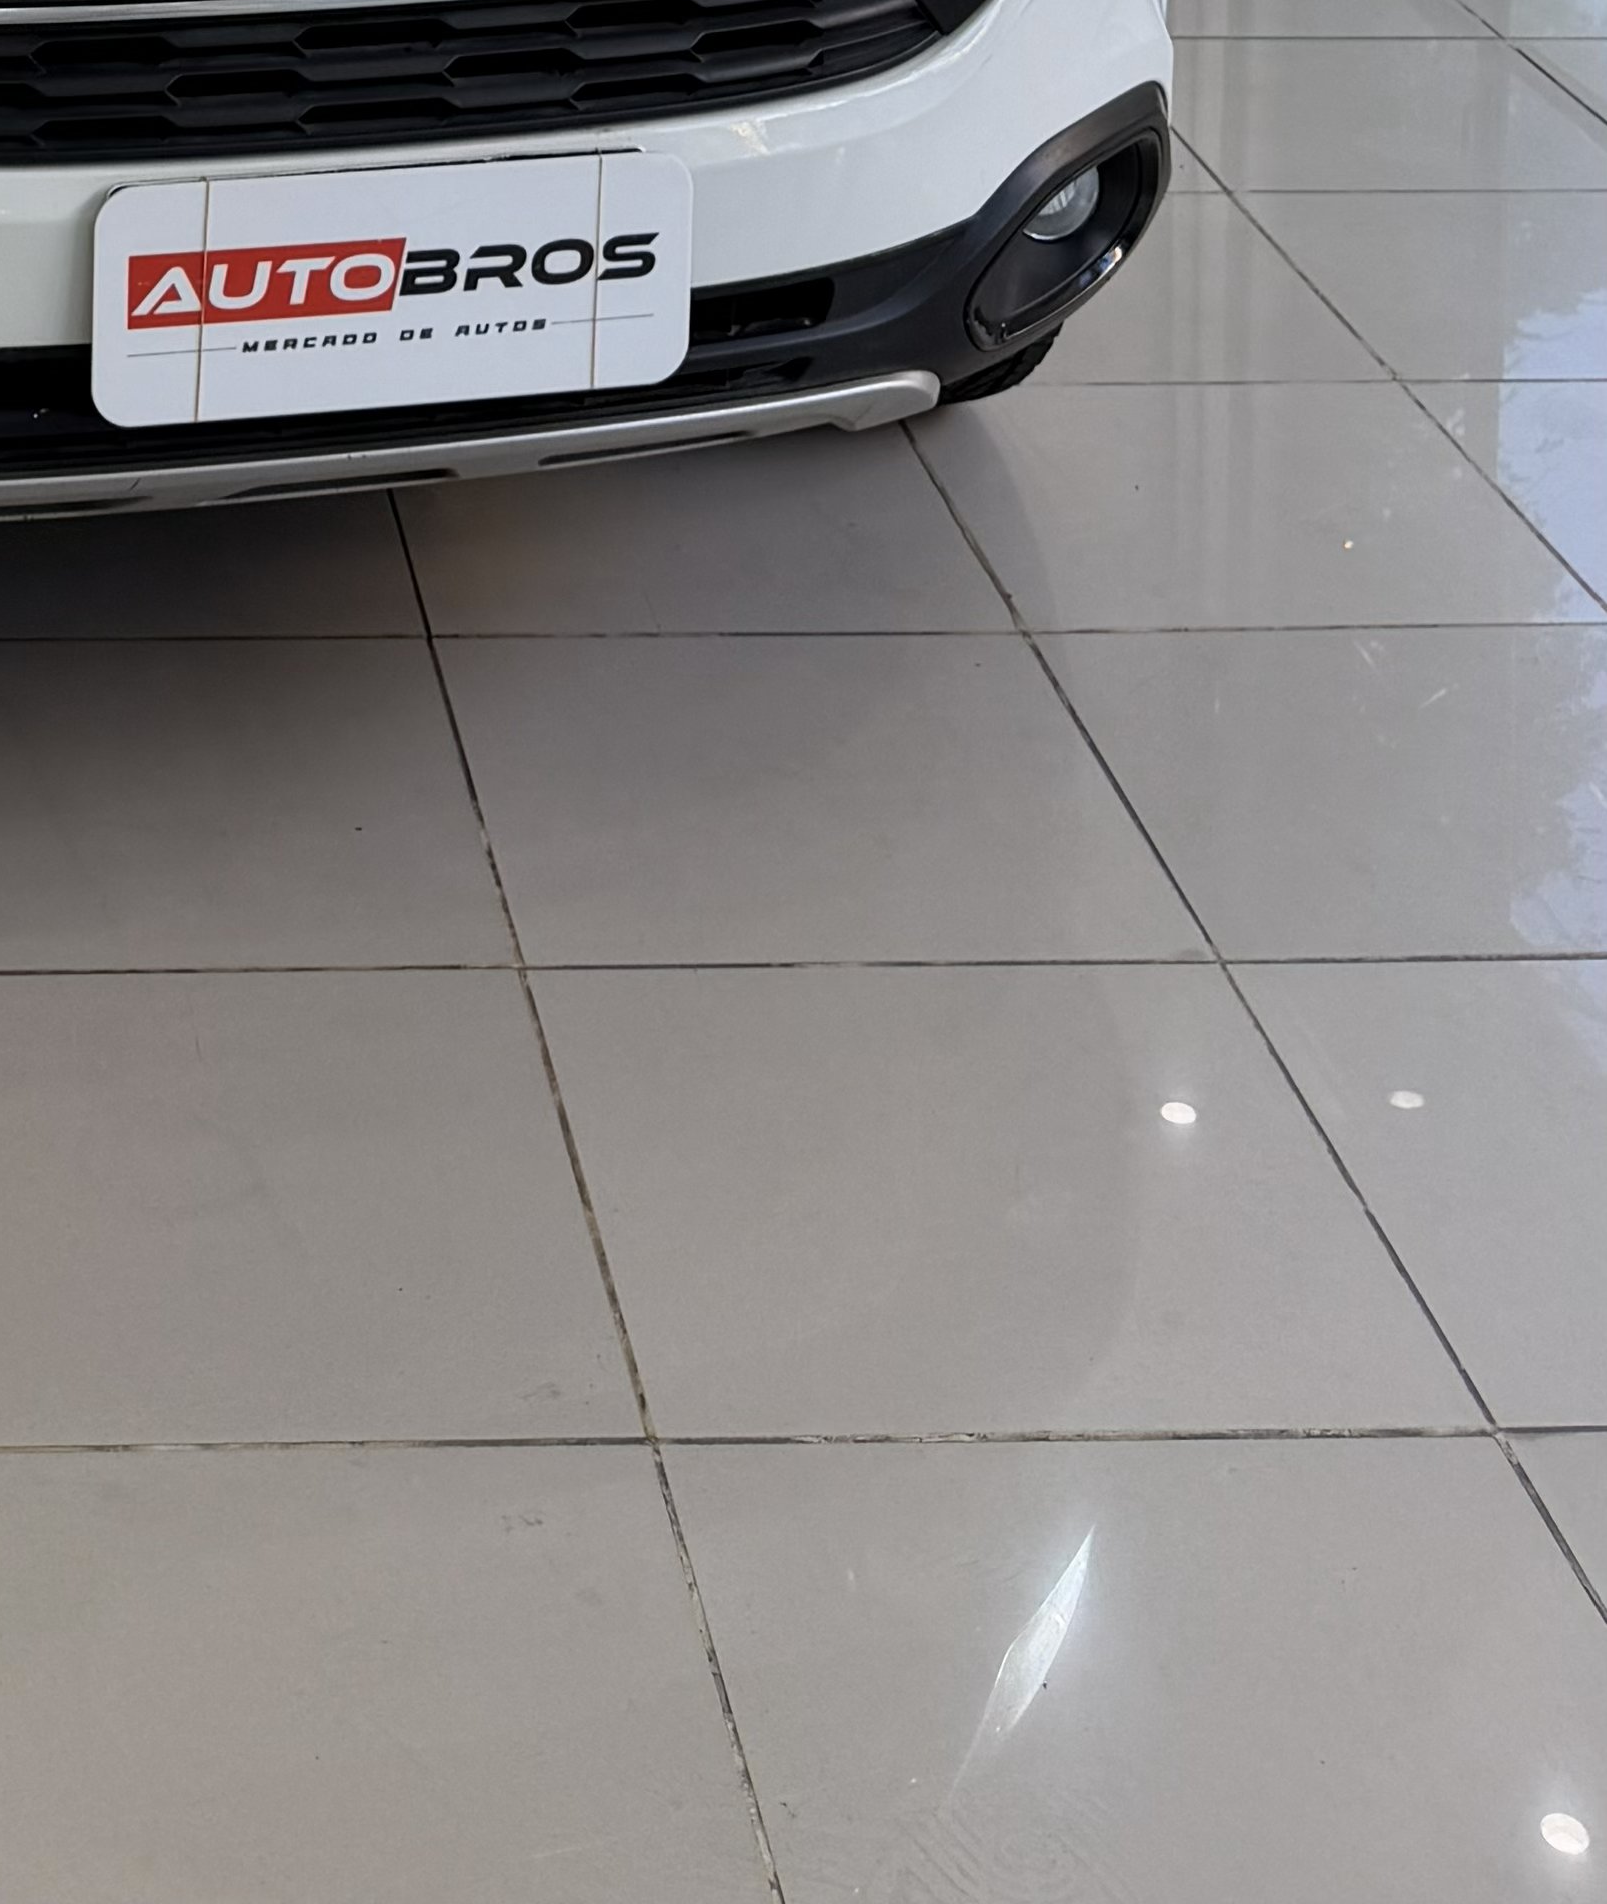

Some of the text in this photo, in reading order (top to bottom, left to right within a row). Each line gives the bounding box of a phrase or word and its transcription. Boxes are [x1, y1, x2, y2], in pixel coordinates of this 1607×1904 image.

[242, 318, 547, 353] MERCADO DE AUTOS
